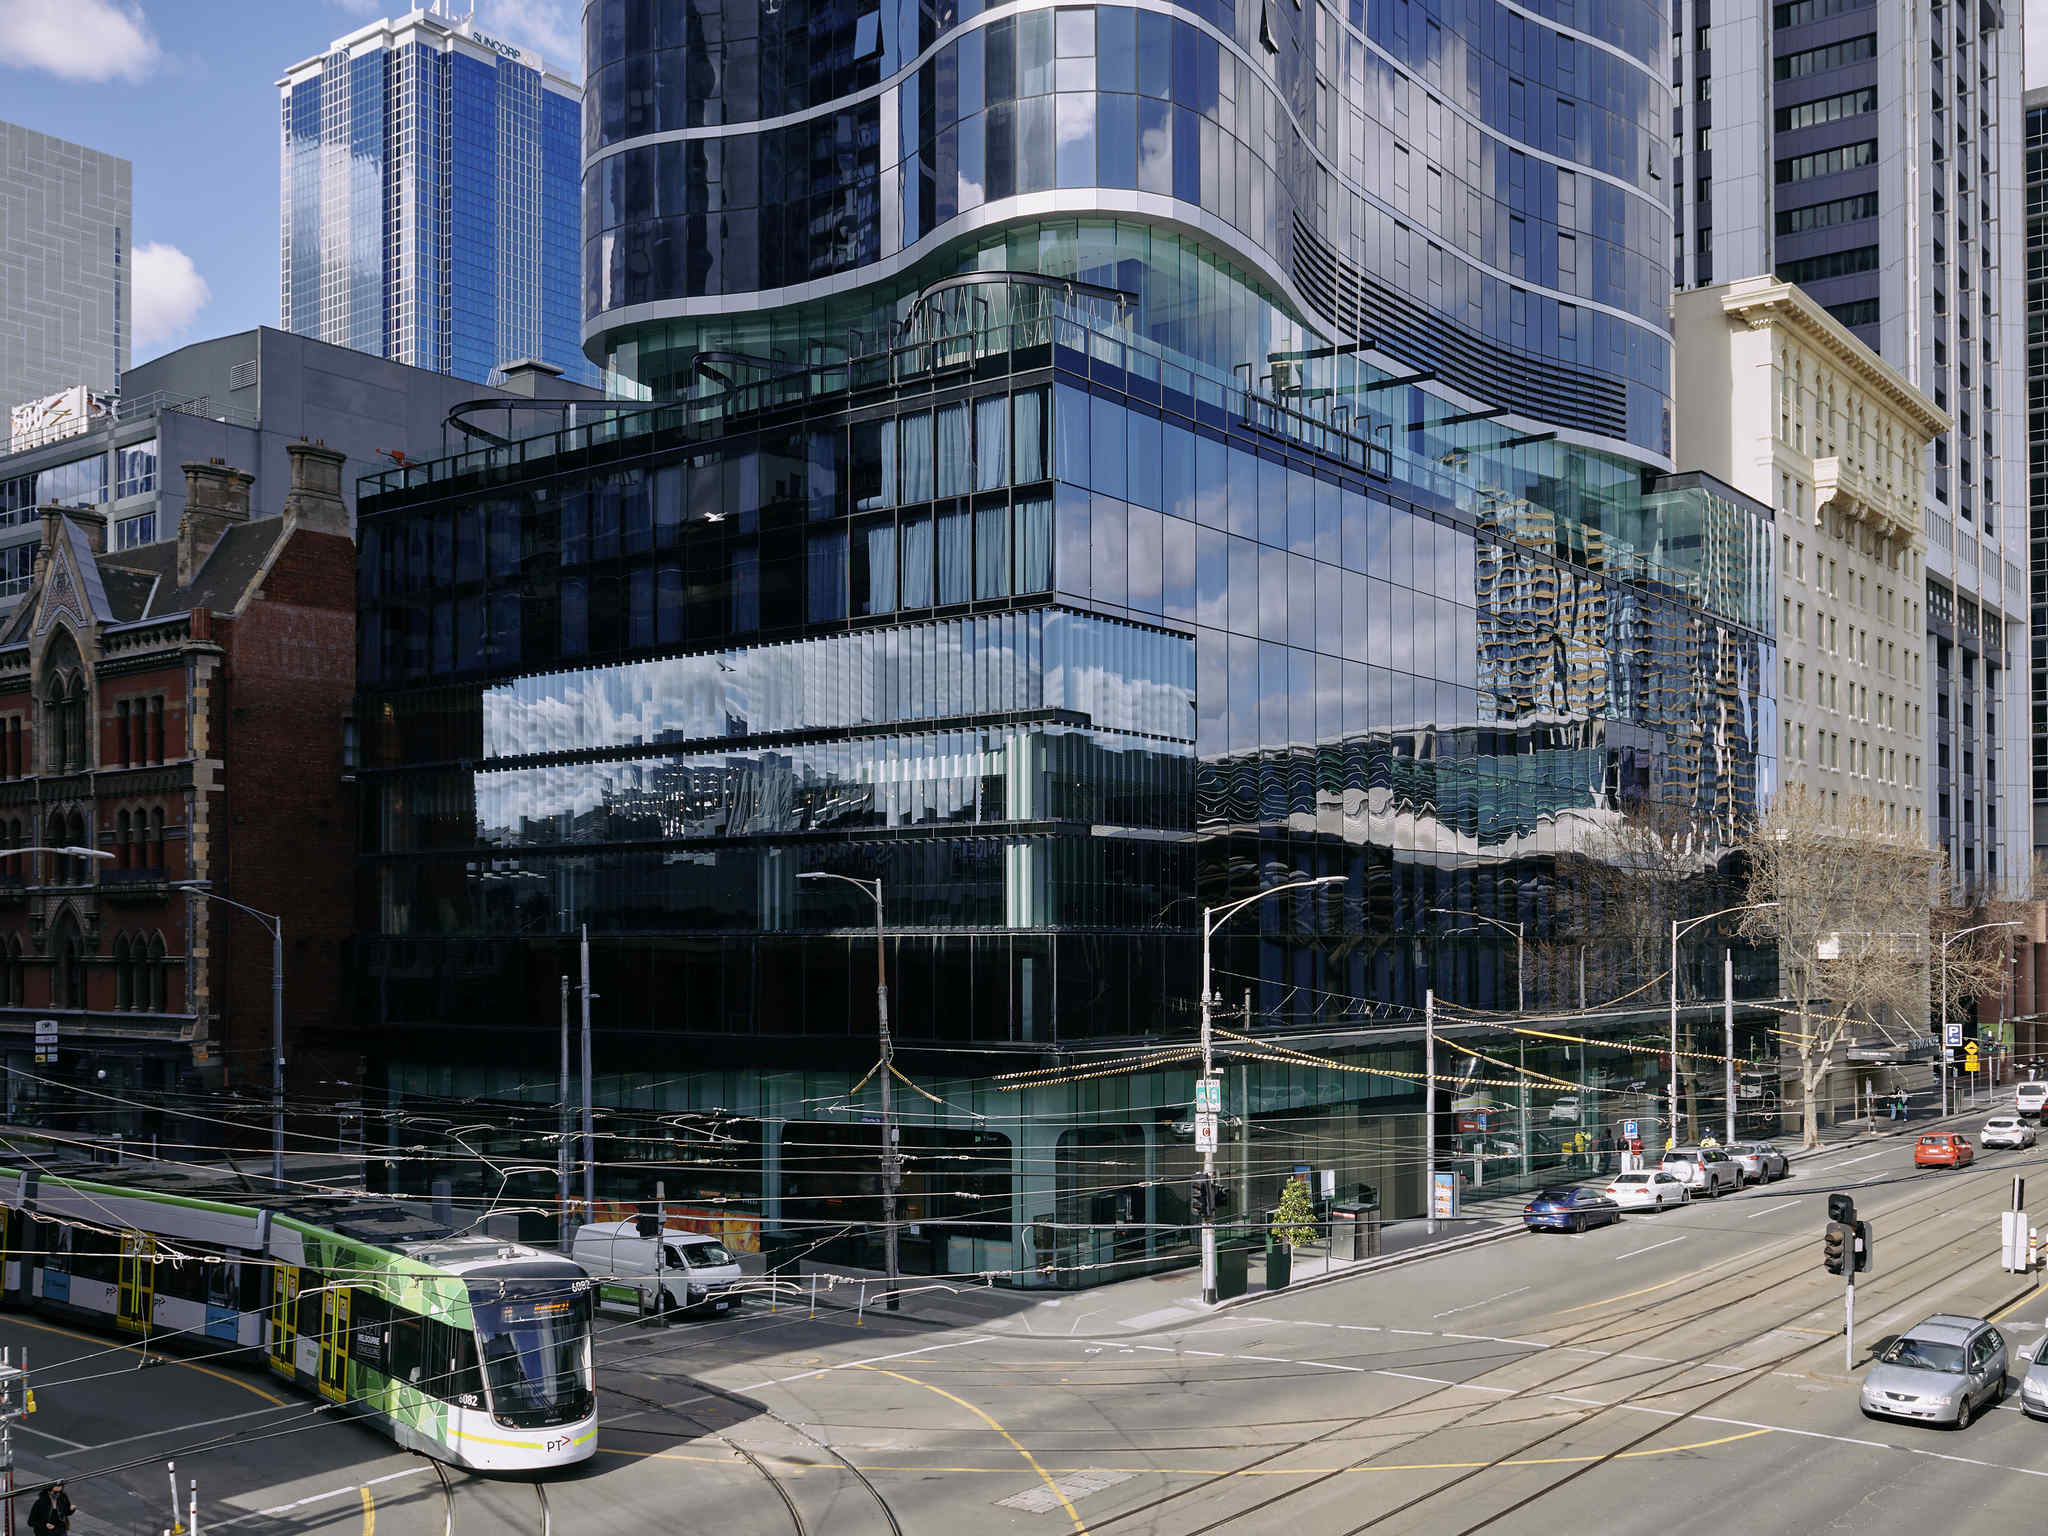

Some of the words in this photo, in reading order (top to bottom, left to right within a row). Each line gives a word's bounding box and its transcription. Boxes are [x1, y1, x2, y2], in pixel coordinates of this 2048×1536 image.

[473, 32, 520, 59] SUNCORP
[1949, 1027, 1958, 1037] P
[572, 1280, 591, 1293] 6082
